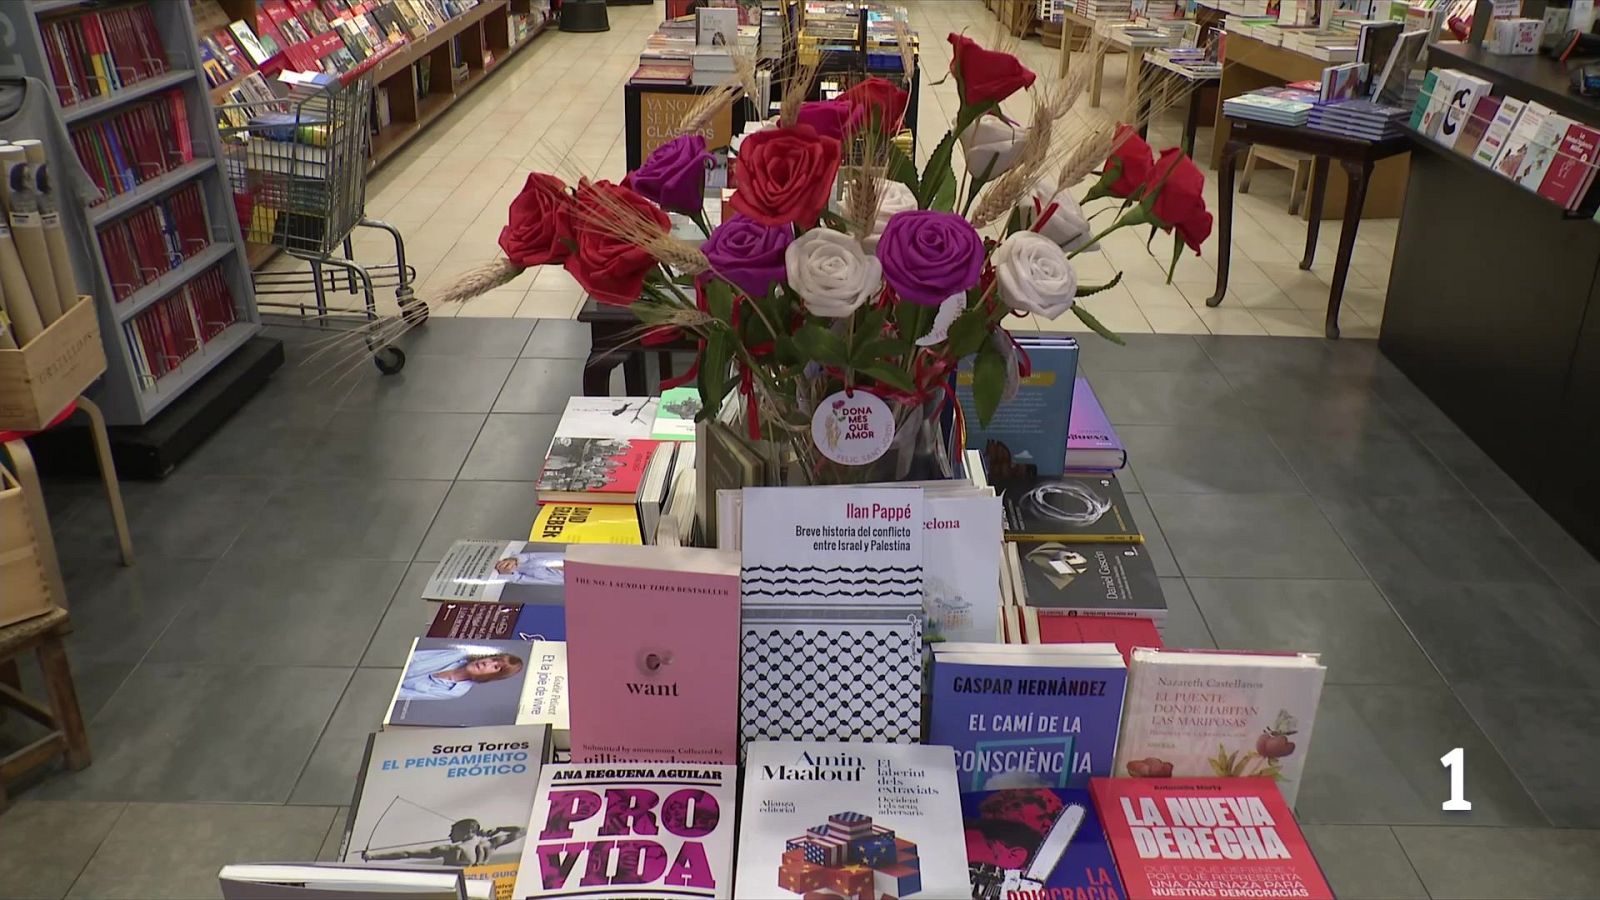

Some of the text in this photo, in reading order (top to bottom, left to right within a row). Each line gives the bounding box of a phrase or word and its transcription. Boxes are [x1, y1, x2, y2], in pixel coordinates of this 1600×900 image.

[666, 100, 687, 110] NO
[647, 126, 714, 139] CLÁSOS
[843, 407, 872, 416] DONA
[849, 415, 867, 423] MÉS
[849, 423, 869, 431] QUE
[845, 432, 874, 440] AMOR
[847, 503, 911, 521] Ilan Pappé
[923, 518, 960, 530] elona
[796, 525, 911, 537] Breve historia del conflicto
[813, 541, 911, 552] entre Israel y Palestina
[616, 581, 646, 590] SUNDAY
[650, 584, 675, 592] TIMES
[677, 586, 729, 596] BESTSELLER
[1102, 573, 1118, 599] Daniel
[531, 655, 555, 715] Et la joie de vivre
[954, 677, 1106, 696] GASPAR HERNÀNDEZ
[1158, 677, 1263, 689] Nazareth Castellanos
[626, 682, 680, 697] want
[1155, 692, 1225, 703] EL PUENTE
[1154, 704, 1259, 716] DONDE HABITAN
[969, 712, 1081, 733] EL CAMÍ DE LA
[1152, 716, 1247, 727] LAS MARIPOSAS
[432, 741, 529, 755] Sara Torres
[583, 744, 620, 752] Submitted
[678, 747, 714, 755] Collected
[382, 752, 528, 771] EL PENSAMIENTO
[796, 751, 862, 766] Amin
[877, 759, 890, 767] El
[955, 748, 1092, 774] CONSCIÈNCIA
[447, 764, 526, 778] ERÓTICO
[553, 769, 722, 780] ANA REQUENA AGUILAR
[760, 765, 866, 782] Maalouf
[878, 768, 925, 778] laberint
[878, 777, 903, 786] dels
[878, 785, 939, 795] extraviats
[539, 788, 720, 840] PRO
[1120, 797, 1276, 827] LA NUEVA
[1130, 826, 1292, 860] DERECHA
[536, 840, 716, 890] VIDA
[1086, 867, 1112, 886] LA
[1146, 873, 1175, 881] POR
[1179, 872, 1208, 881] QUÉ
[1149, 880, 1305, 889] UNA AMENAZA PARA
[1152, 888, 1309, 897] NUESTRAS DEMOCRACIAS
